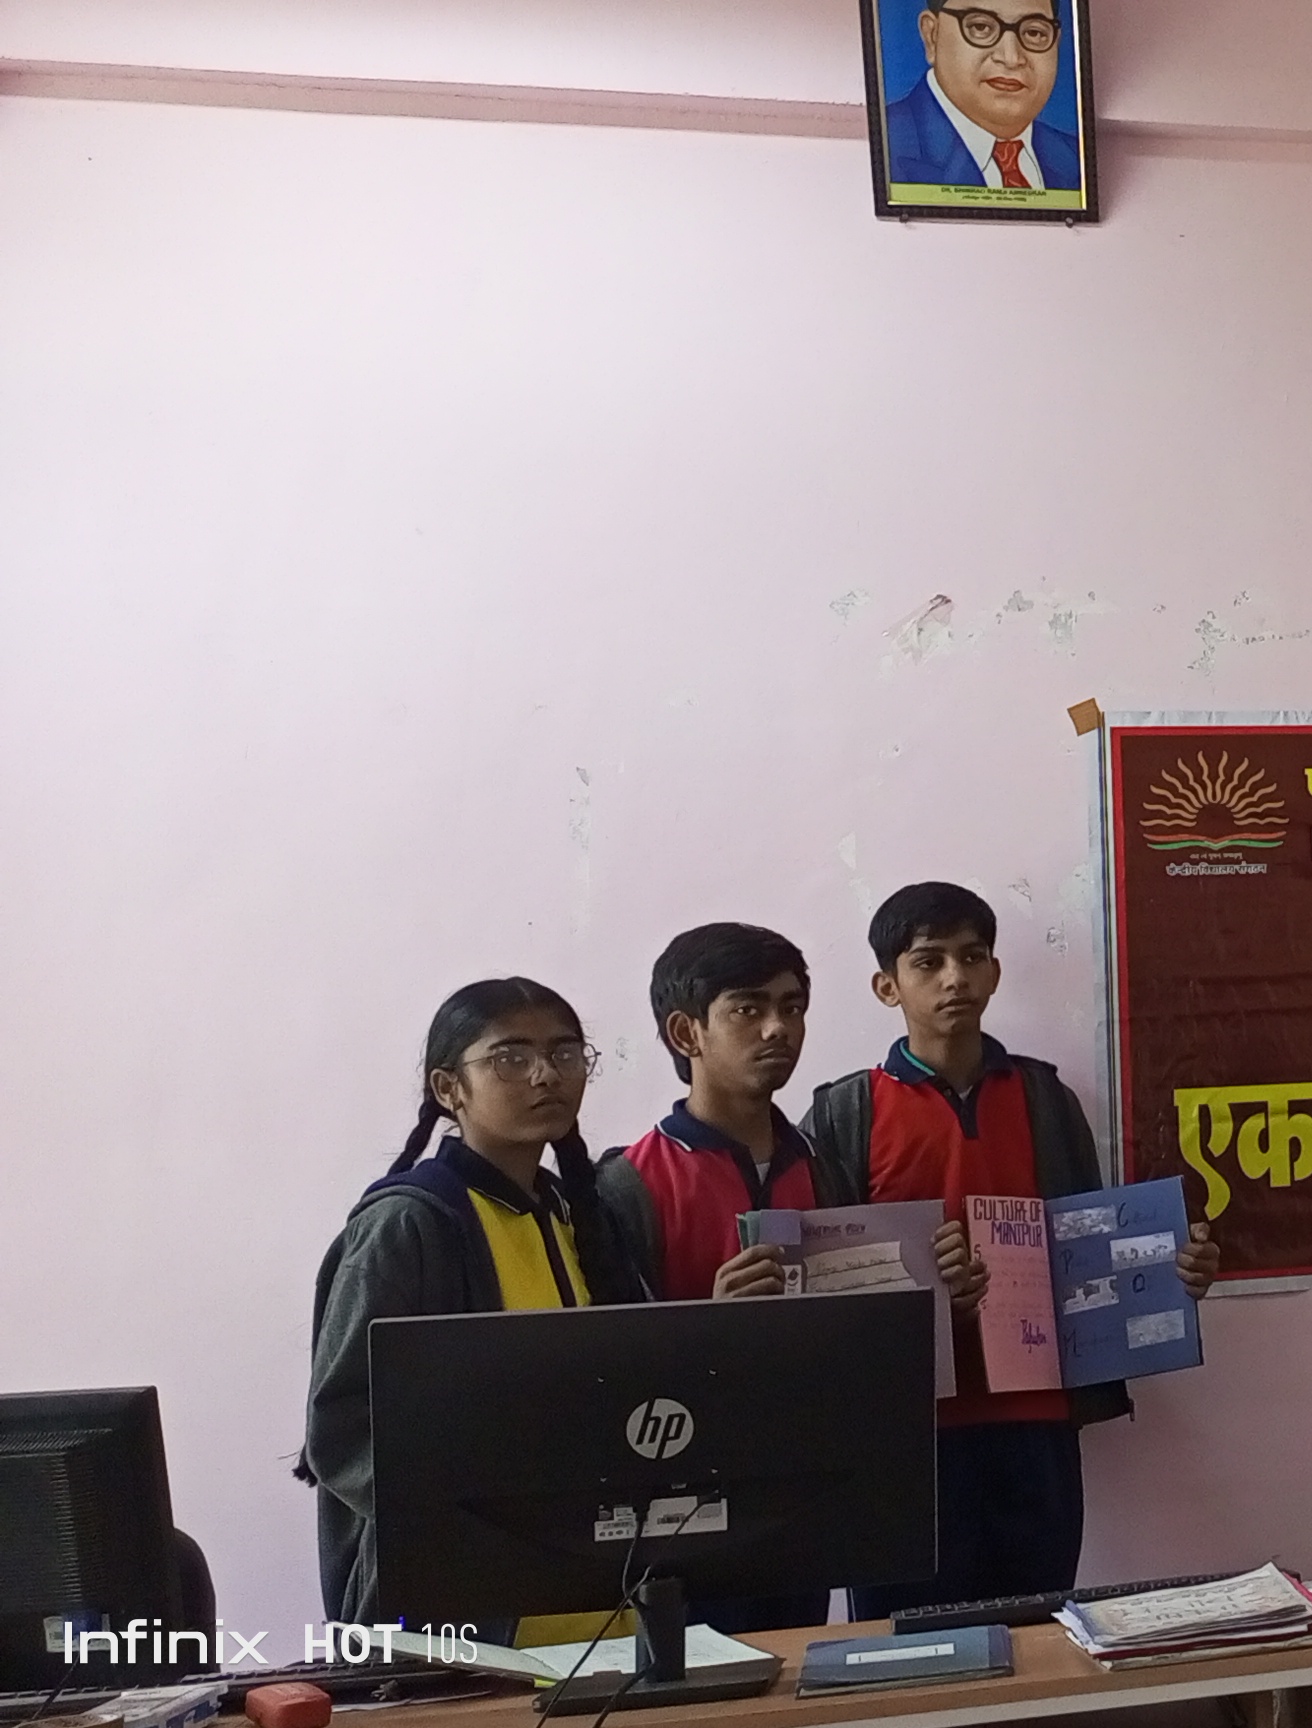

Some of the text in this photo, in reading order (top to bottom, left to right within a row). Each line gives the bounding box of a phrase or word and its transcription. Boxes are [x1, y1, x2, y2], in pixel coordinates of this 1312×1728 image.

[974, 1197, 1041, 1223] CULTURE OF
[991, 1220, 1044, 1249] MANIPUR
[635, 1399, 687, 1460] hp
